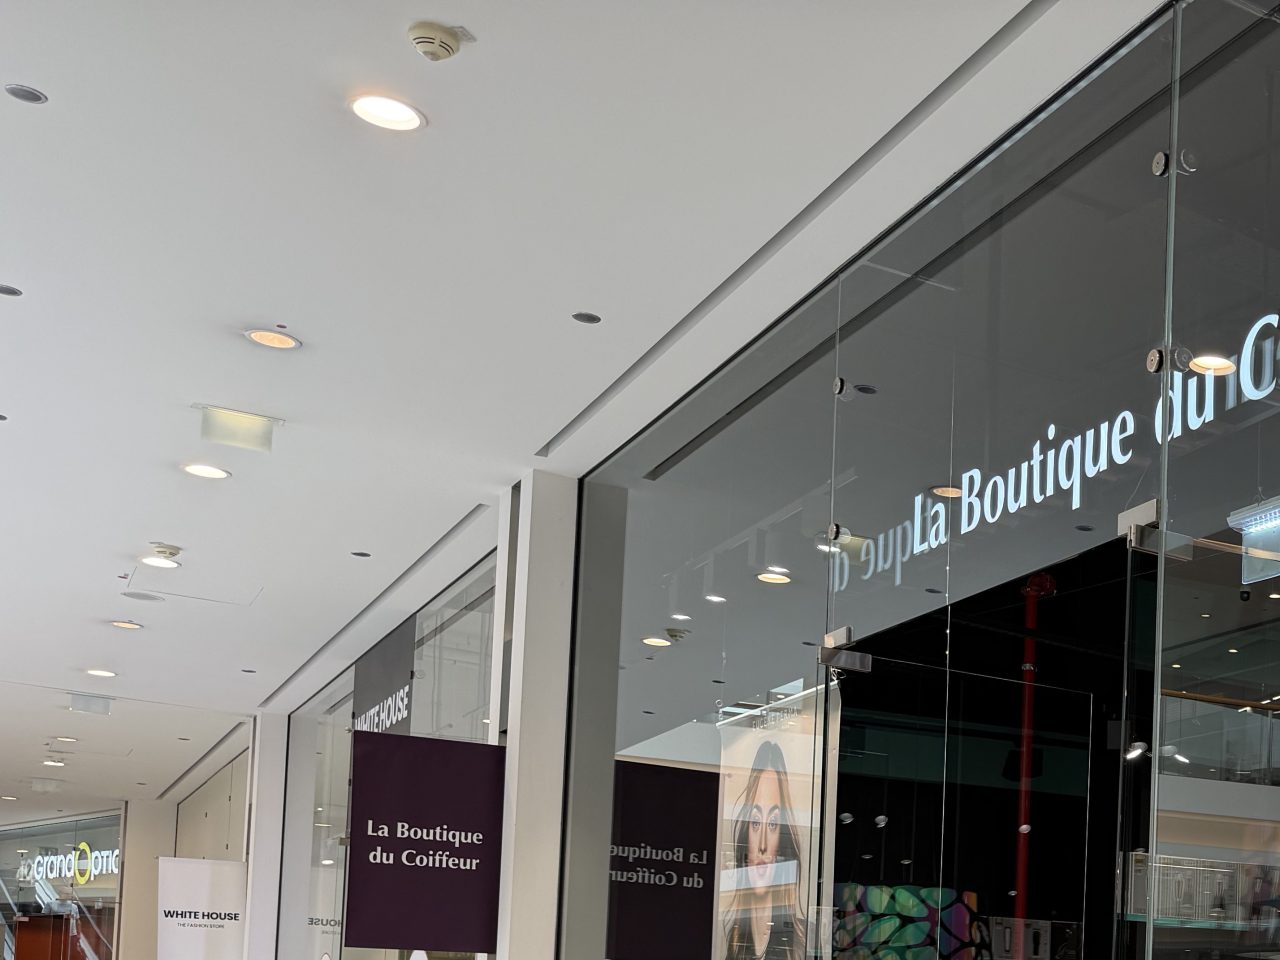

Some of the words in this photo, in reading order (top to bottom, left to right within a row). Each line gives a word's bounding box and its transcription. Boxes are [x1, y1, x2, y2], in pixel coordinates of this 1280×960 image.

[913, 493, 947, 555] La
[961, 410, 1135, 535] Boutique
[1155, 368, 1214, 445] du
[367, 820, 389, 838] La
[396, 822, 484, 847] Boutique
[369, 846, 394, 865] du
[401, 849, 480, 870] Coiffeur
[163, 909, 200, 920] WHITE
[201, 911, 240, 921] HOUSE
